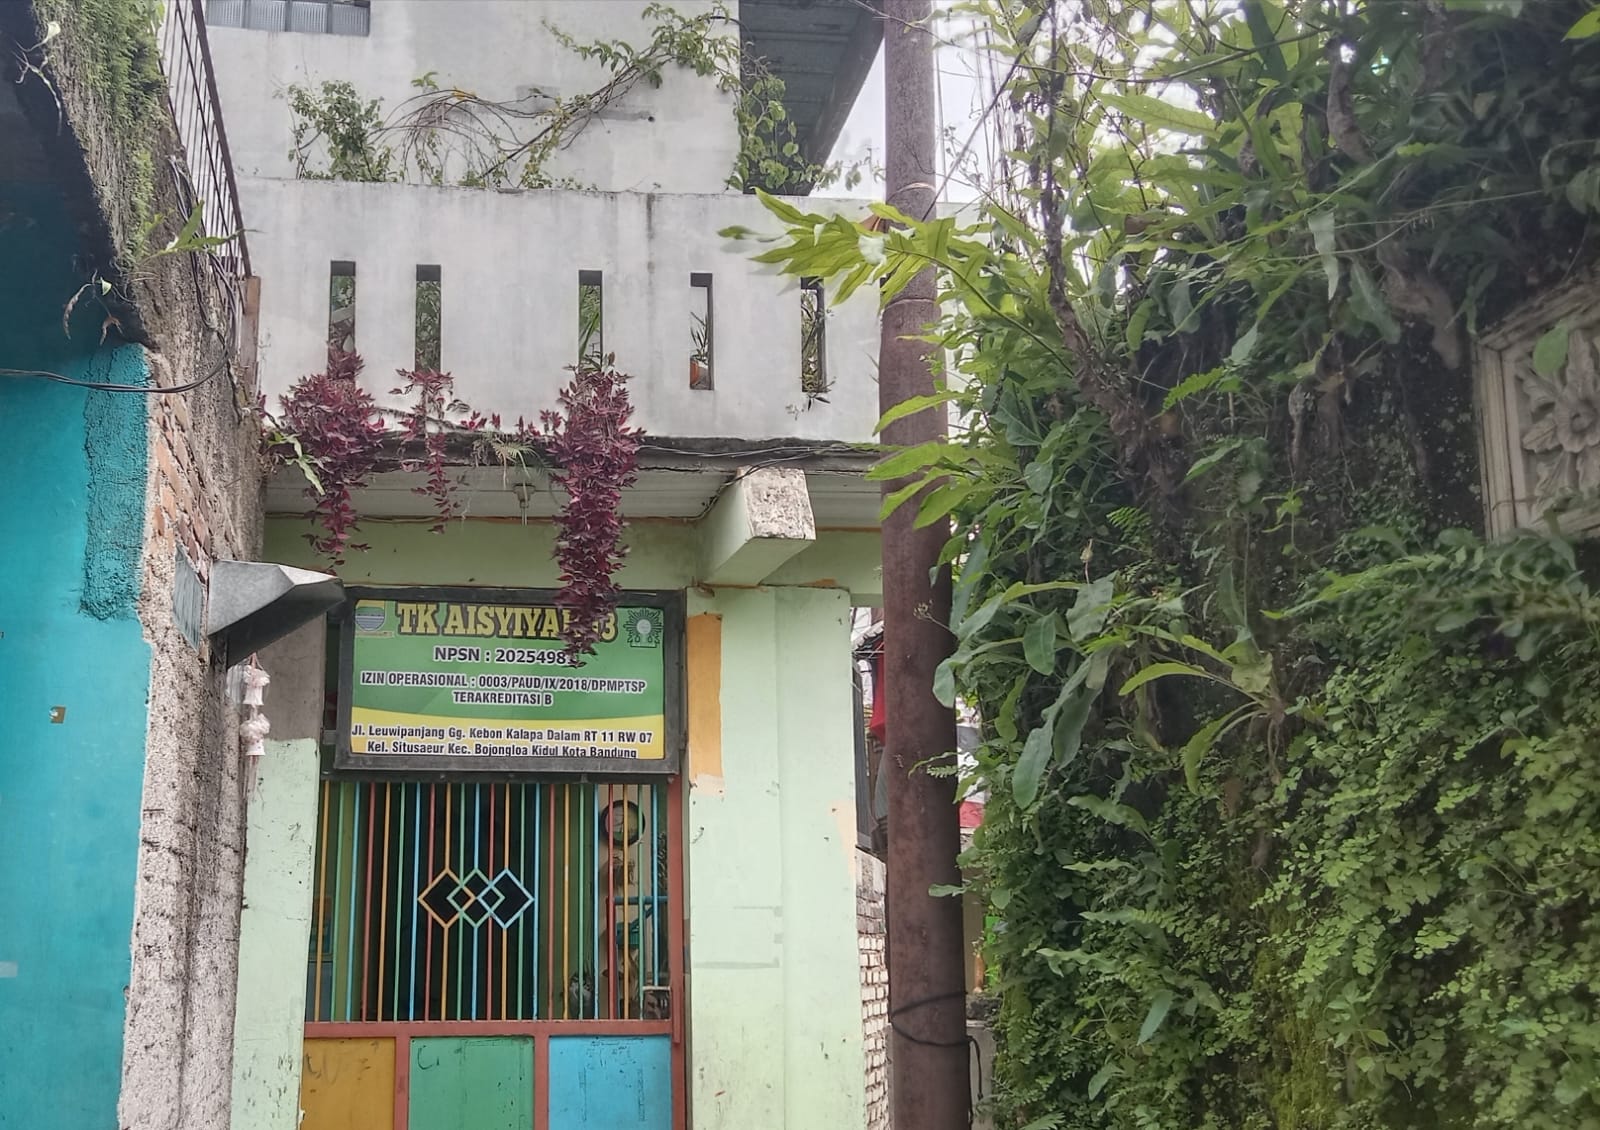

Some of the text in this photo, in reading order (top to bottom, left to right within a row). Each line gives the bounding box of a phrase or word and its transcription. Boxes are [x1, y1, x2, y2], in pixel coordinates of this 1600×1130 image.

[397, 602, 438, 634] TK
[434, 647, 480, 662] NPSN
[496, 649, 576, 665] 2025498
[362, 672, 385, 684] IZIN
[388, 672, 467, 687] OPERASIONAL
[479, 676, 646, 693] 0003/PAUD/IX/2018/DPMPTSP
[453, 691, 552, 705] TERAKREDITASI B
[351, 725, 652, 743] Jl. Leuwipanjang Gg. Kebon Kalapa Dalam RT 11 RW 07
[367, 740, 388, 753] Kel.
[392, 741, 445, 754] Situsaeur
[448, 742, 471, 754] Kec.
[474, 743, 528, 757] Bojongloa
[532, 745, 559, 756] Kidul
[562, 746, 587, 757] Kota
